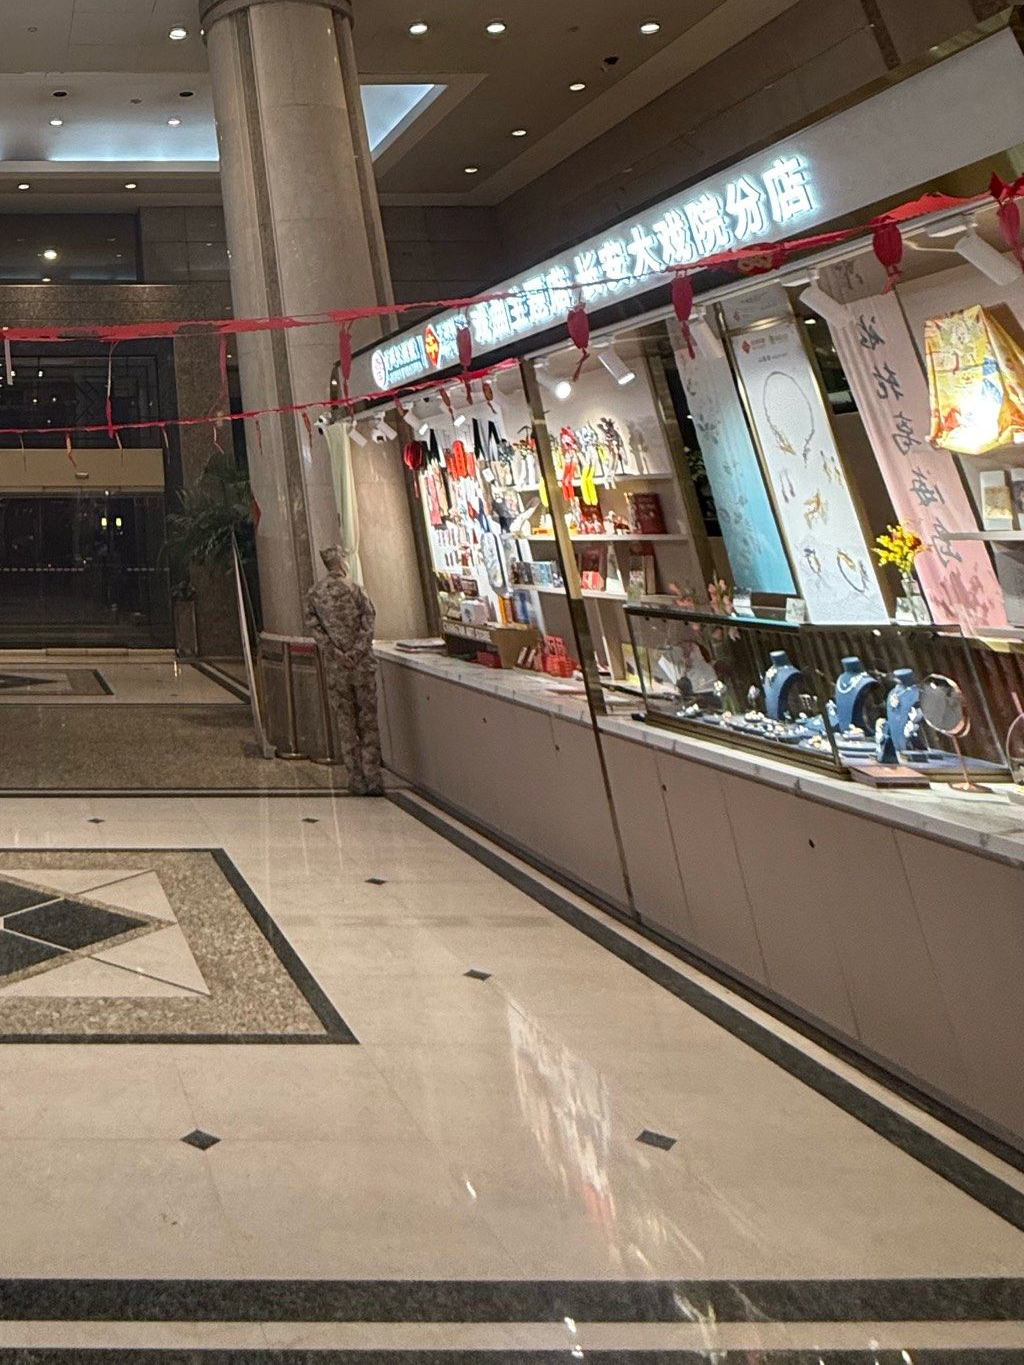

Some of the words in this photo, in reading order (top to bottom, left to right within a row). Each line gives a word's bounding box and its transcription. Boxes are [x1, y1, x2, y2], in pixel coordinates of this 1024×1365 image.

[574, 157, 814, 301] 长安大戏院分店
